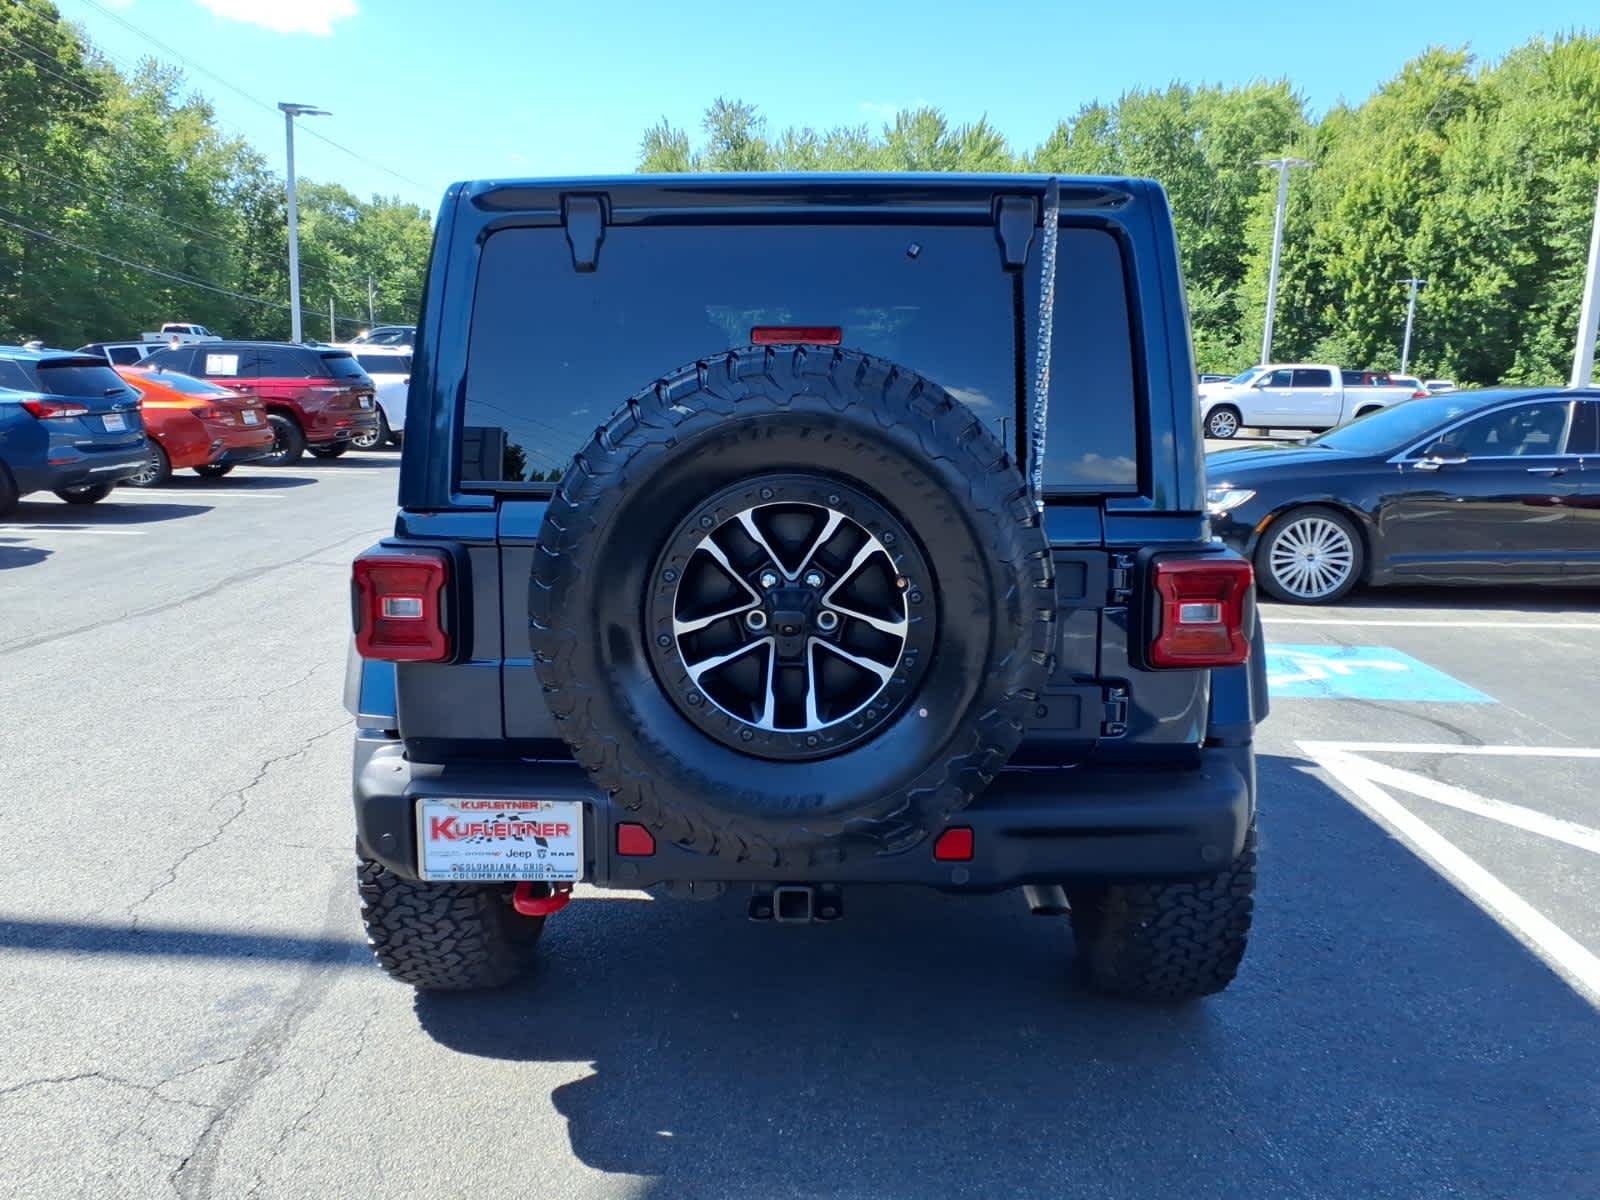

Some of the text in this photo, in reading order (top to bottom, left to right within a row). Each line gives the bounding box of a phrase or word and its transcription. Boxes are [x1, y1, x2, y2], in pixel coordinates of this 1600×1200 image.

[461, 800, 539, 810] KUFLEITNER
[430, 815, 571, 842] KUFLEITNER
[506, 848, 532, 859] Jeep
[523, 863, 544, 873] OHIO
[522, 872, 544, 880] OHIO
